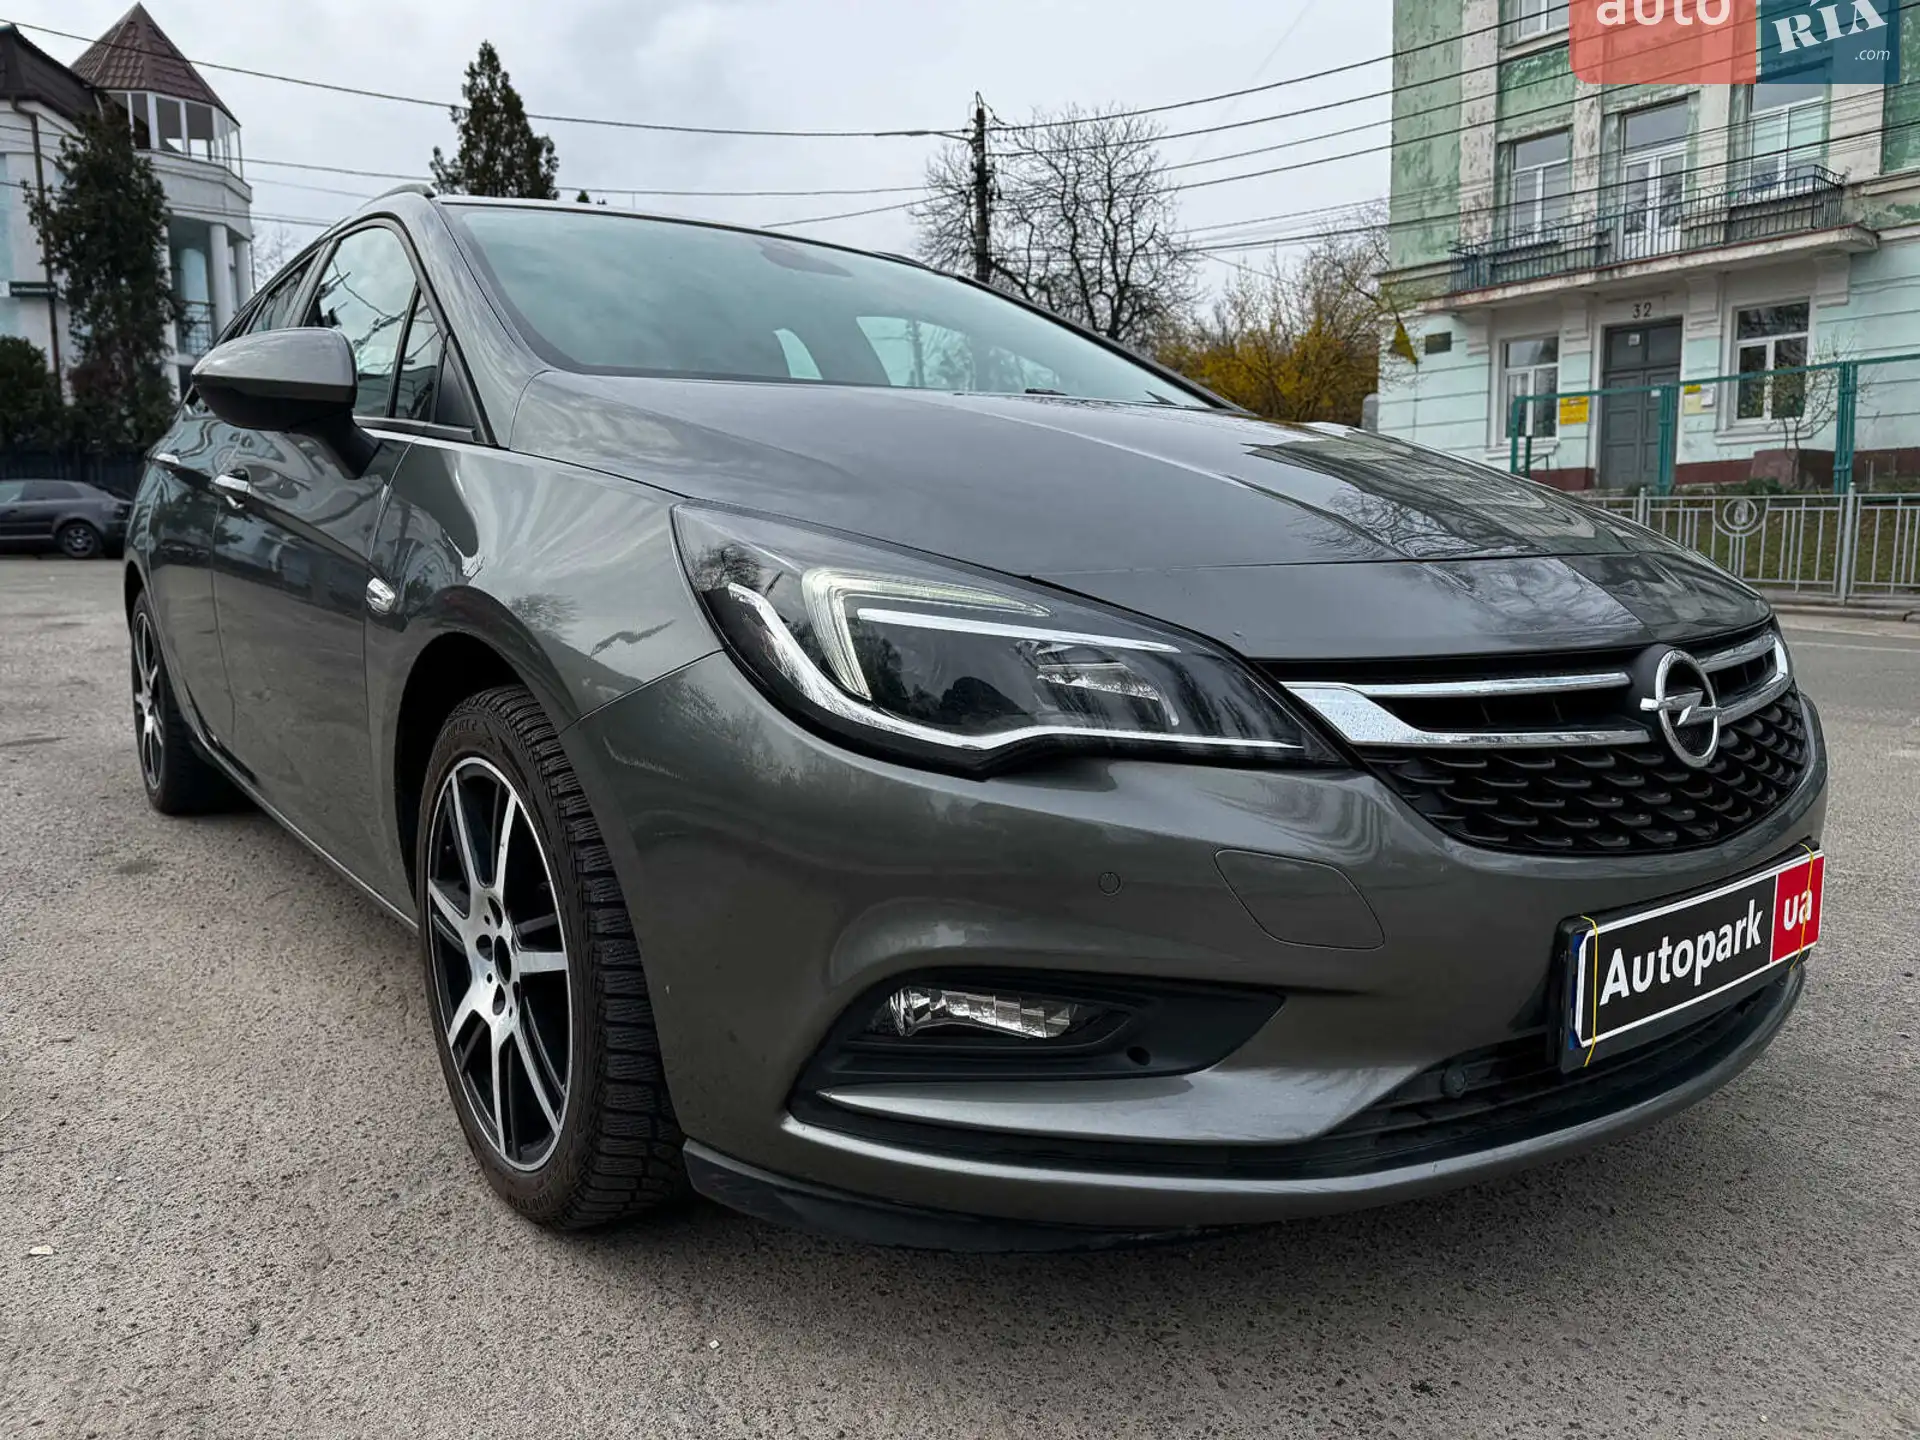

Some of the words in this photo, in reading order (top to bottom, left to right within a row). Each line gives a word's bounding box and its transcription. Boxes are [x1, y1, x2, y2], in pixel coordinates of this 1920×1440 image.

[1632, 301, 1653, 320] 32
[1599, 898, 1764, 1007] Autopark
[1783, 889, 1813, 931] ua
